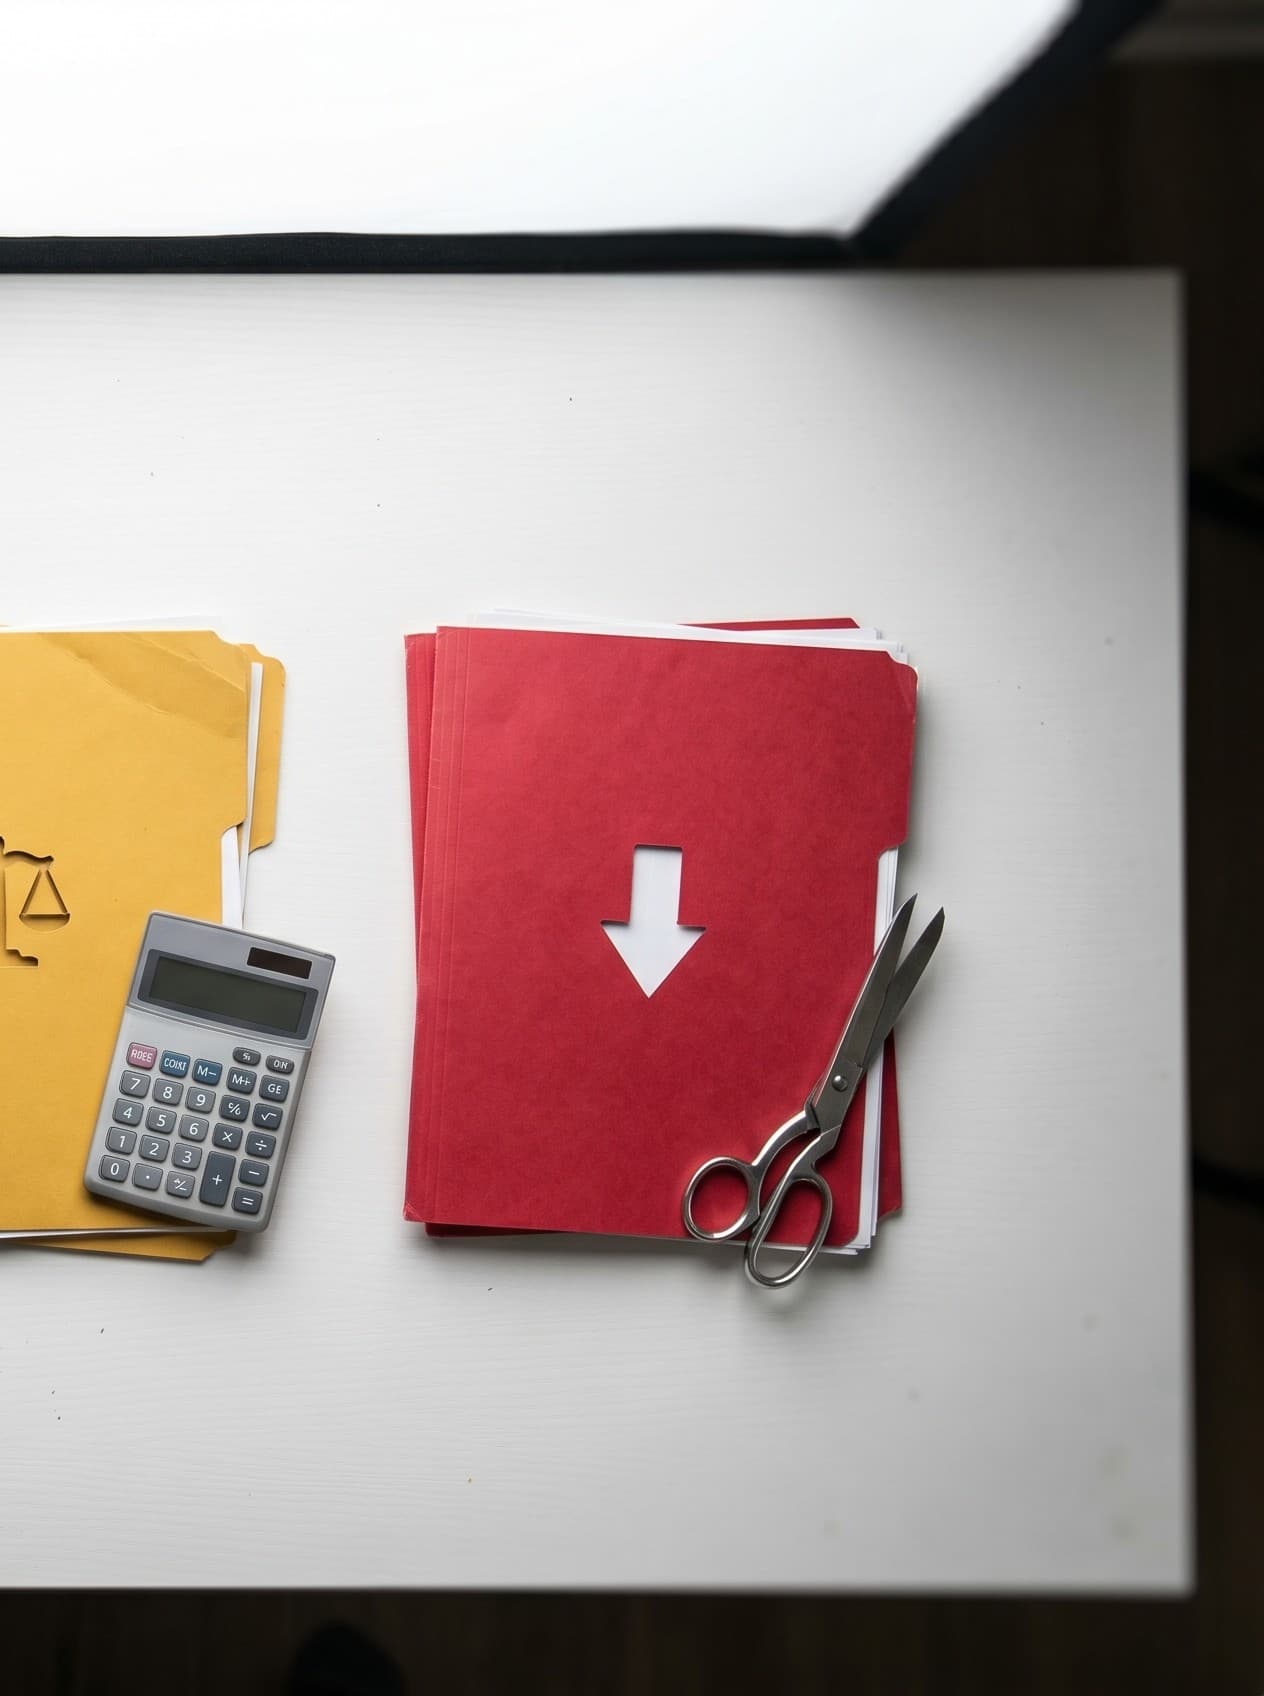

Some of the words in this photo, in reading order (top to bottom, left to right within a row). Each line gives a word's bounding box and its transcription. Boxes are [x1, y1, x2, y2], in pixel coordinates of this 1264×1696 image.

[130, 1077, 141, 1090] 7
[162, 1086, 173, 1099] 8
[195, 1094, 206, 1107] 9
[123, 1107, 133, 1119] 4
[156, 1114, 167, 1127] 5
[189, 1122, 200, 1136] 6
[118, 1135, 126, 1148] 1
[149, 1142, 160, 1156] 2
[182, 1150, 193, 1164] 3
[110, 1162, 120, 1175] 0
